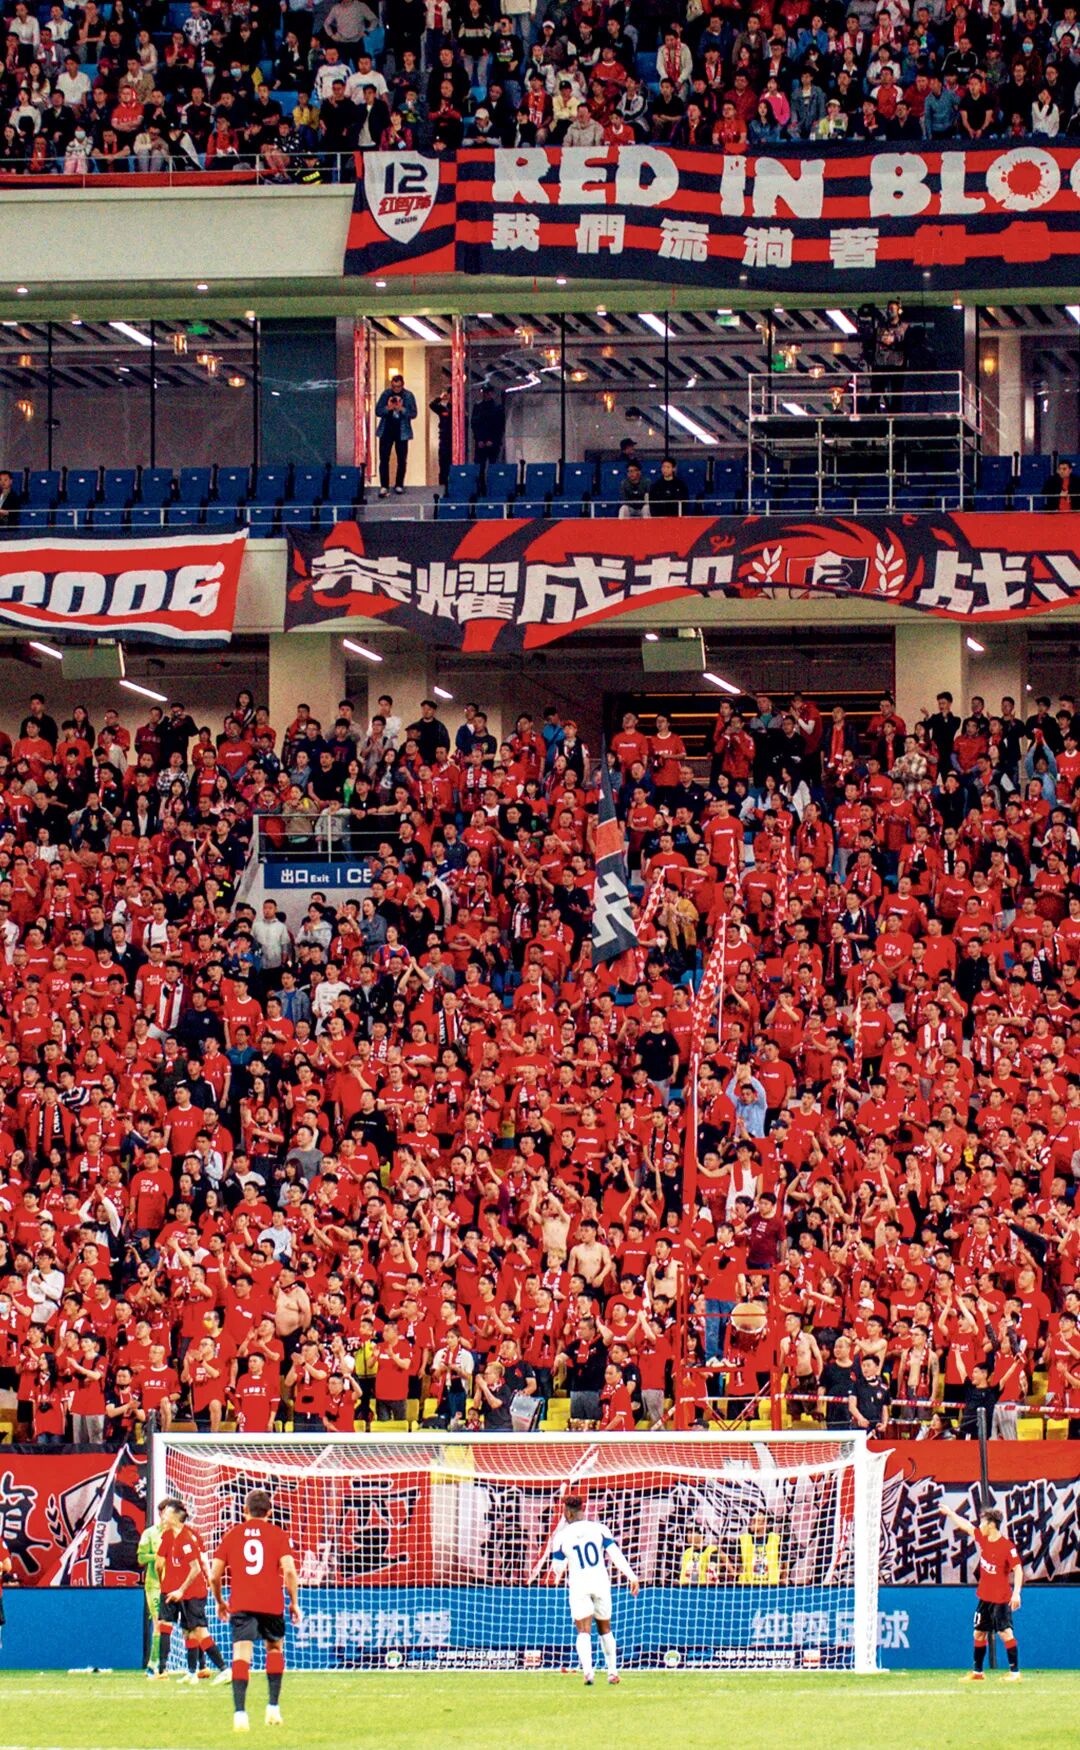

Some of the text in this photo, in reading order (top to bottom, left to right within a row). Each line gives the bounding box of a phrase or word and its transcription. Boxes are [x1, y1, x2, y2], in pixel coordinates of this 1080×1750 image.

[384, 162, 428, 195] 12
[492, 145, 1080, 218] RED IN BLO
[281, 868, 308, 884] 出口
[310, 874, 330, 883] Exit
[243, 1538, 264, 1576] 9
[572, 1541, 599, 1569] 10
